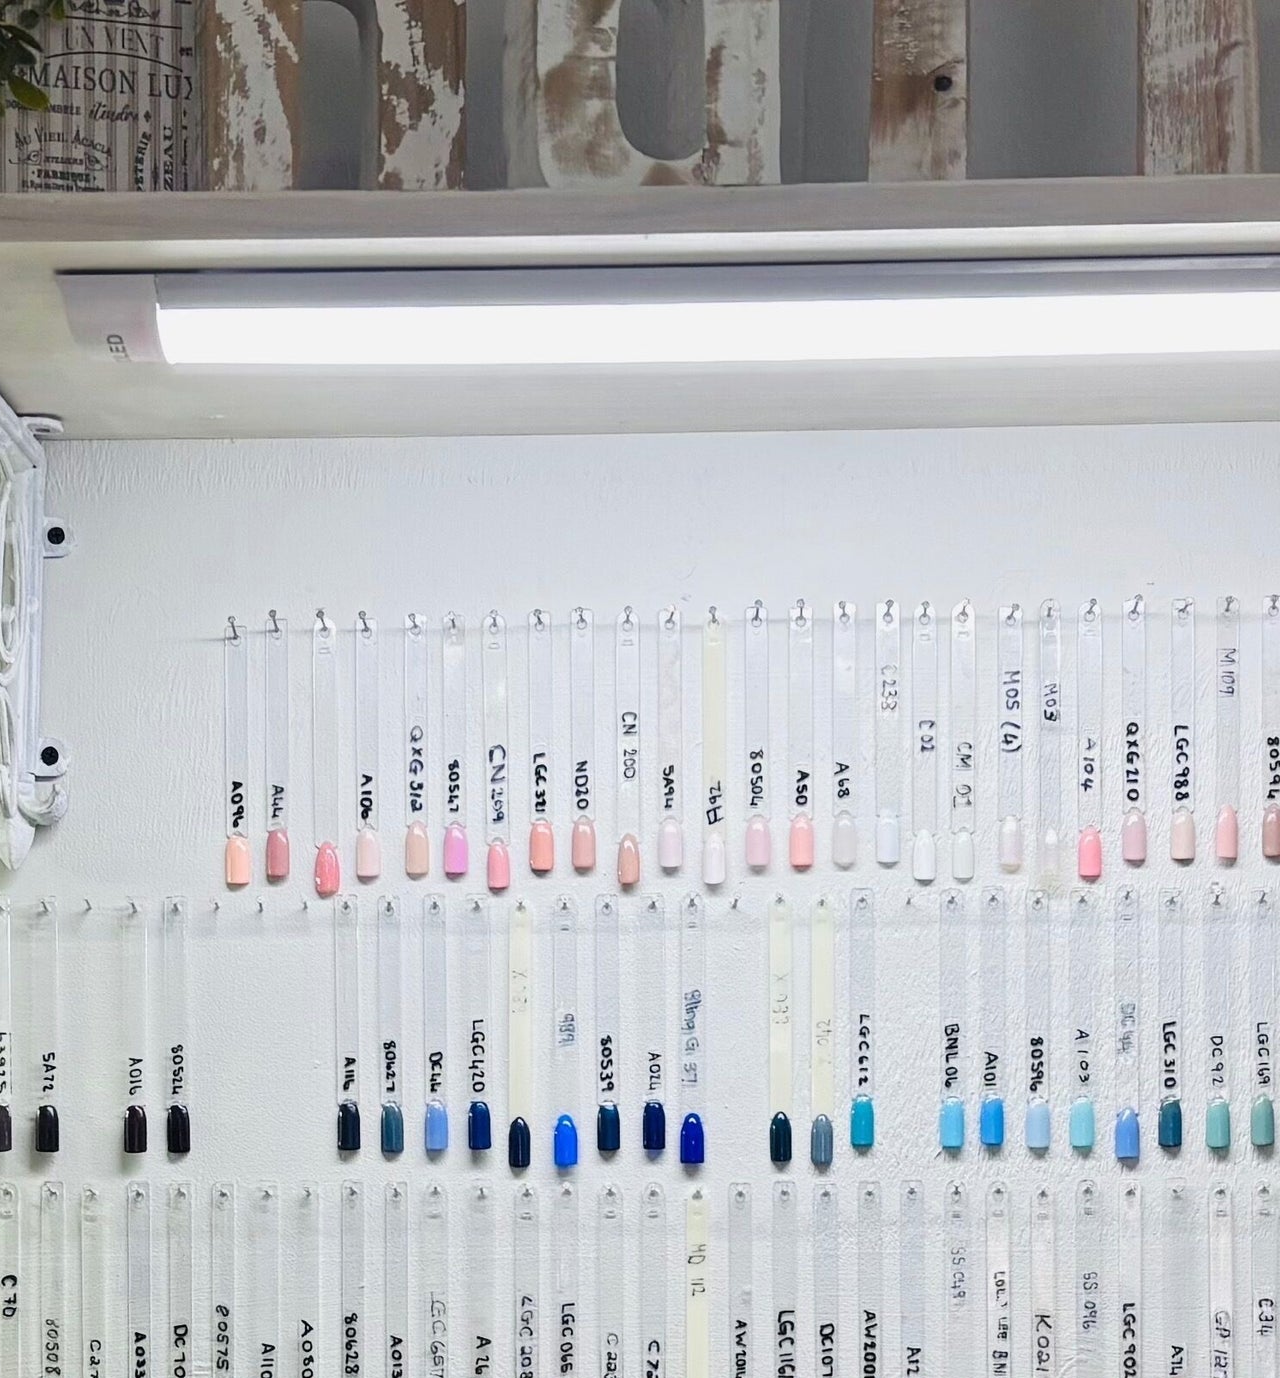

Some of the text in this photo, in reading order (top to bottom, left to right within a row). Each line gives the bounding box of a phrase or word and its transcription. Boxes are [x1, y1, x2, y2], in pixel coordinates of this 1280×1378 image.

[28, 62, 137, 95] MAISON
[1174, 724, 1190, 801] LGC988
[230, 780, 244, 829] A096
[360, 773, 374, 819] A106
[128, 1056, 144, 1097] A016
[170, 1044, 184, 1096] 80524
[469, 1018, 486, 1093] LGC420
[599, 1034, 614, 1092] 80539
[1029, 1036, 1045, 1092] 80596
[1255, 1021, 1270, 1085] LGC169
[345, 1312, 358, 1375] 80628
